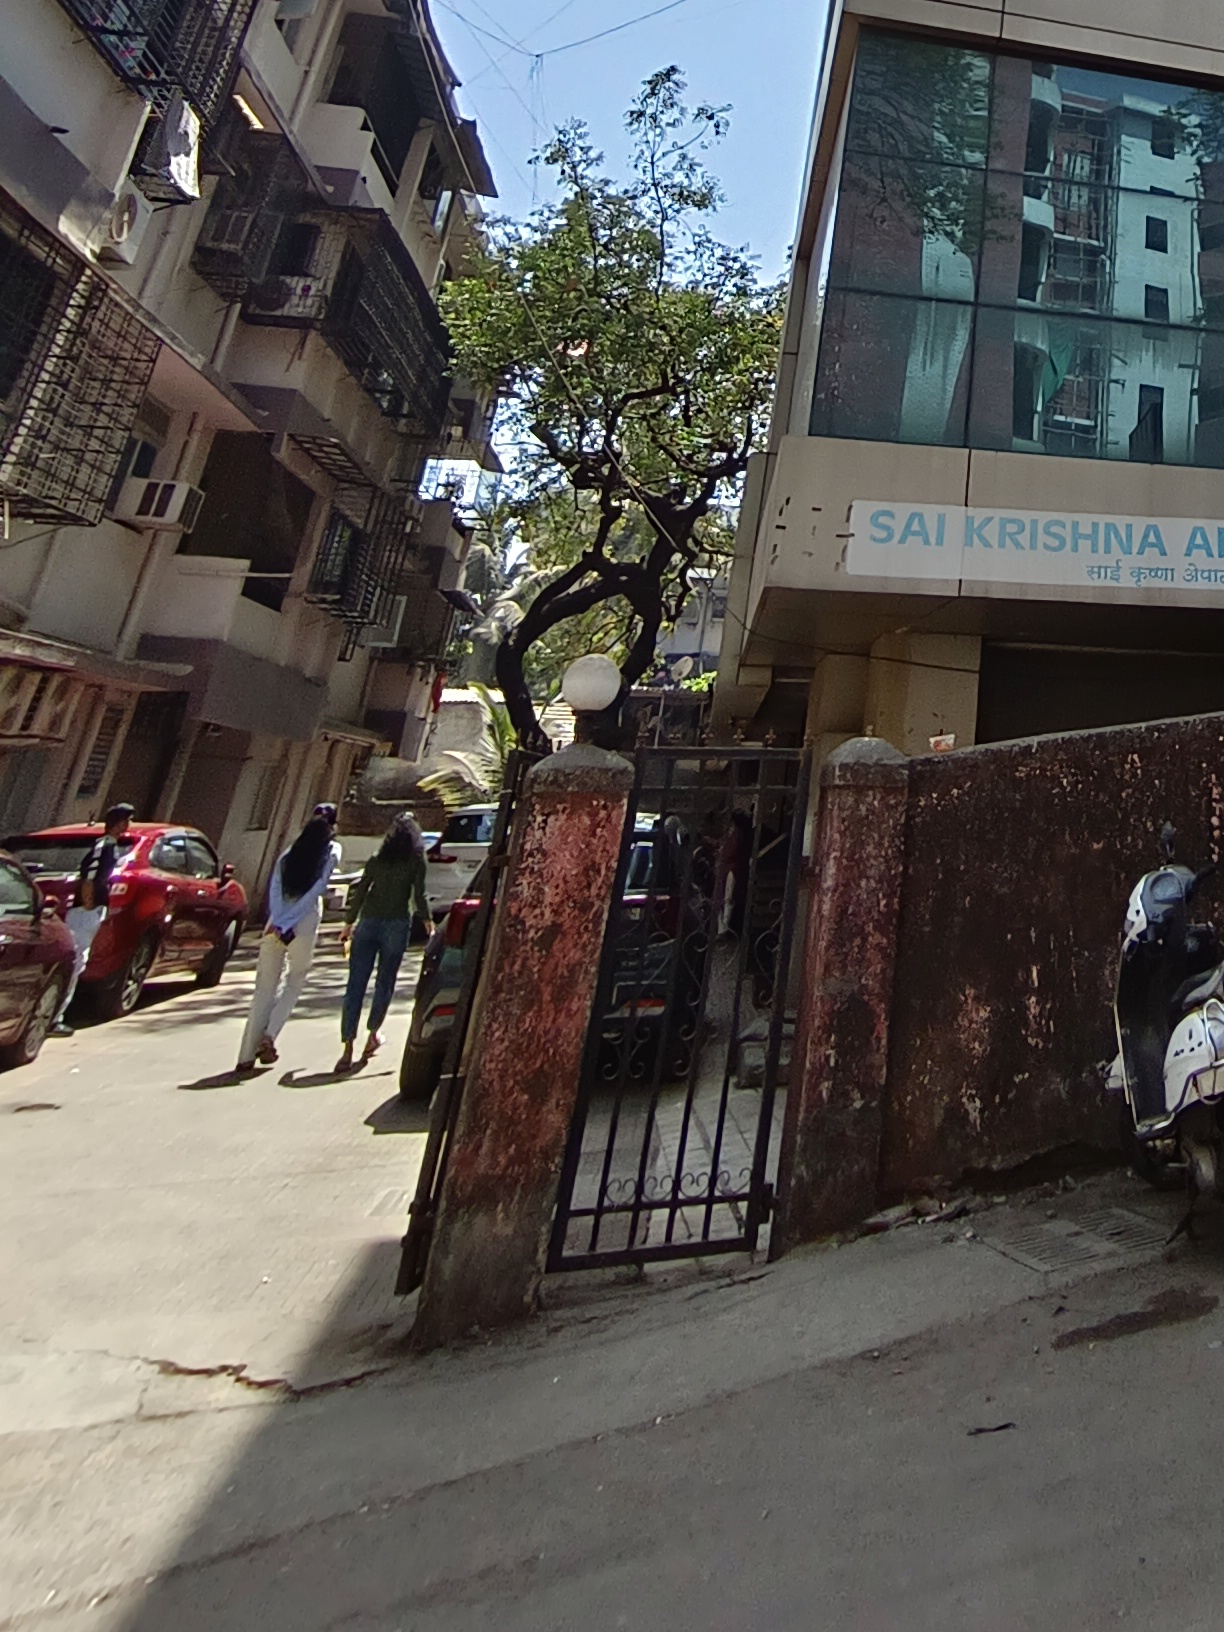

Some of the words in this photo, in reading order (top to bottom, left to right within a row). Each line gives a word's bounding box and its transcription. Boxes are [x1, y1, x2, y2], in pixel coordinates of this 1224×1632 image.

[868, 509, 947, 547] SAI
[964, 515, 1169, 557] KRISHNA
[1085, 559, 1122, 581] साई
[1128, 565, 1175, 587] कृष्णा
